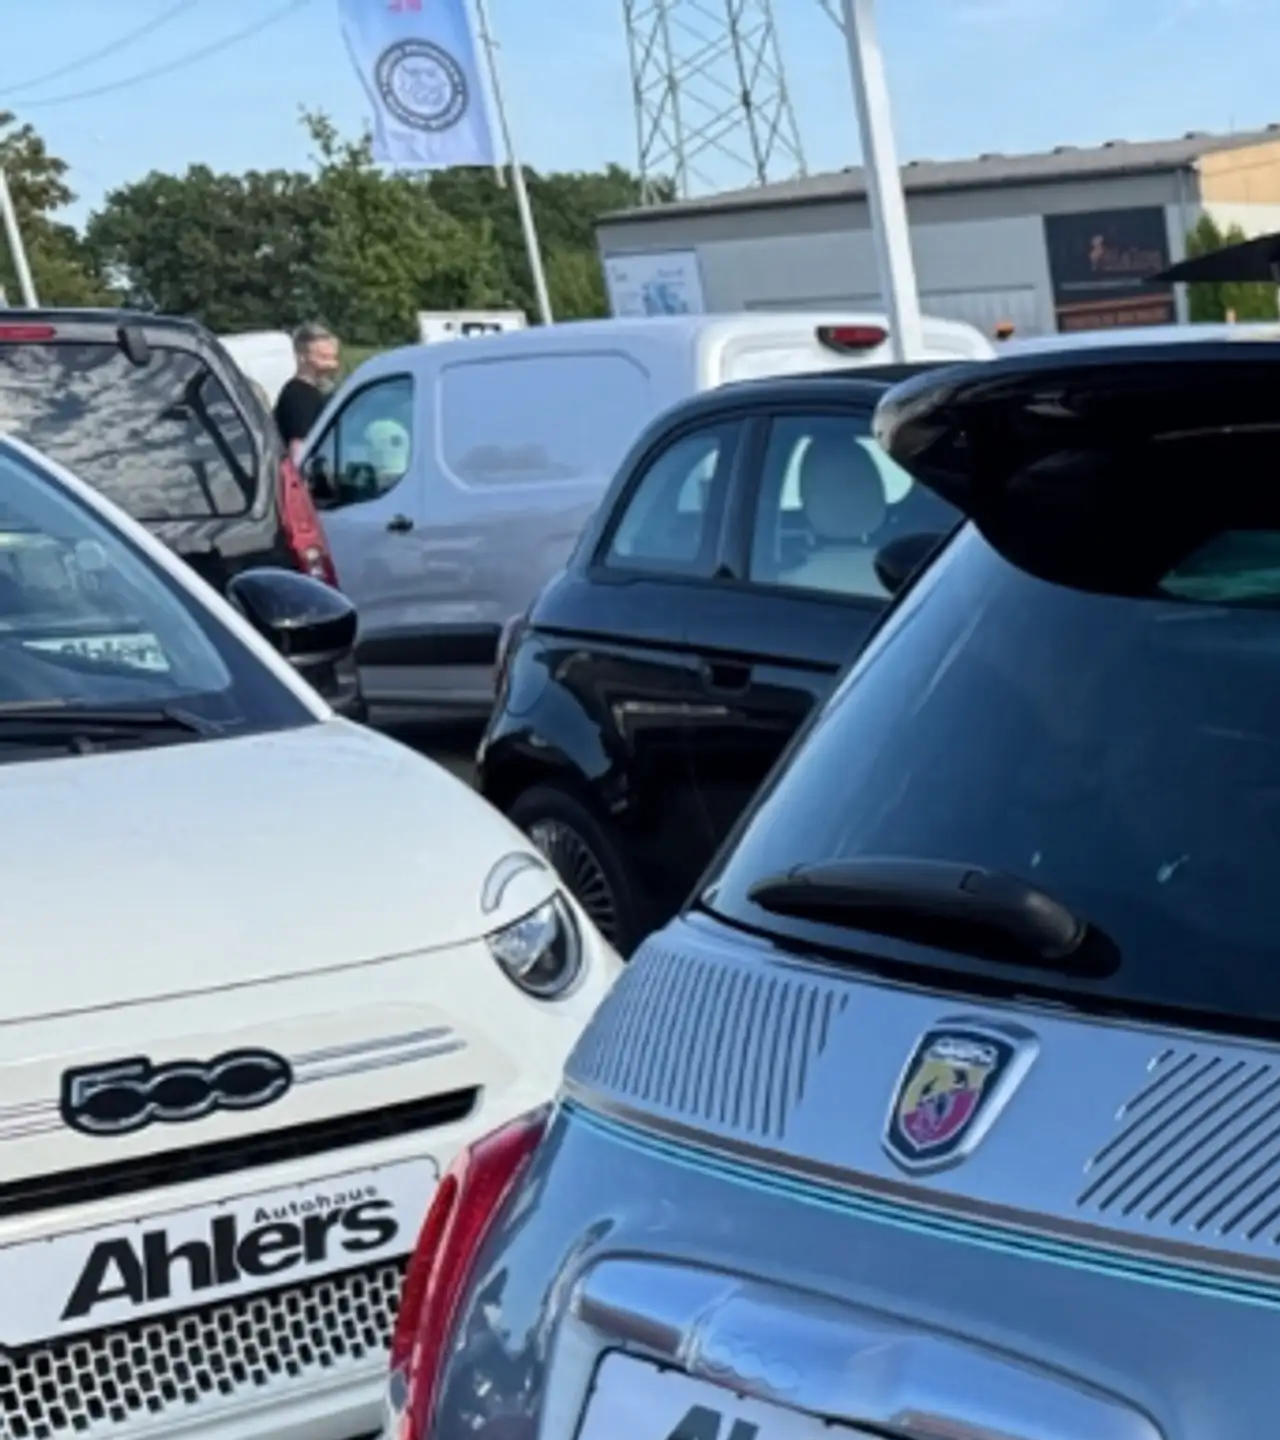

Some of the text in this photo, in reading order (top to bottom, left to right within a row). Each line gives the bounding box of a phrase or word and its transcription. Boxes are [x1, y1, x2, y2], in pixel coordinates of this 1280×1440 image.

[61, 1047, 293, 1136] 500
[254, 1185, 378, 1223] Autohaus
[60, 1199, 399, 1321] Ahlers
